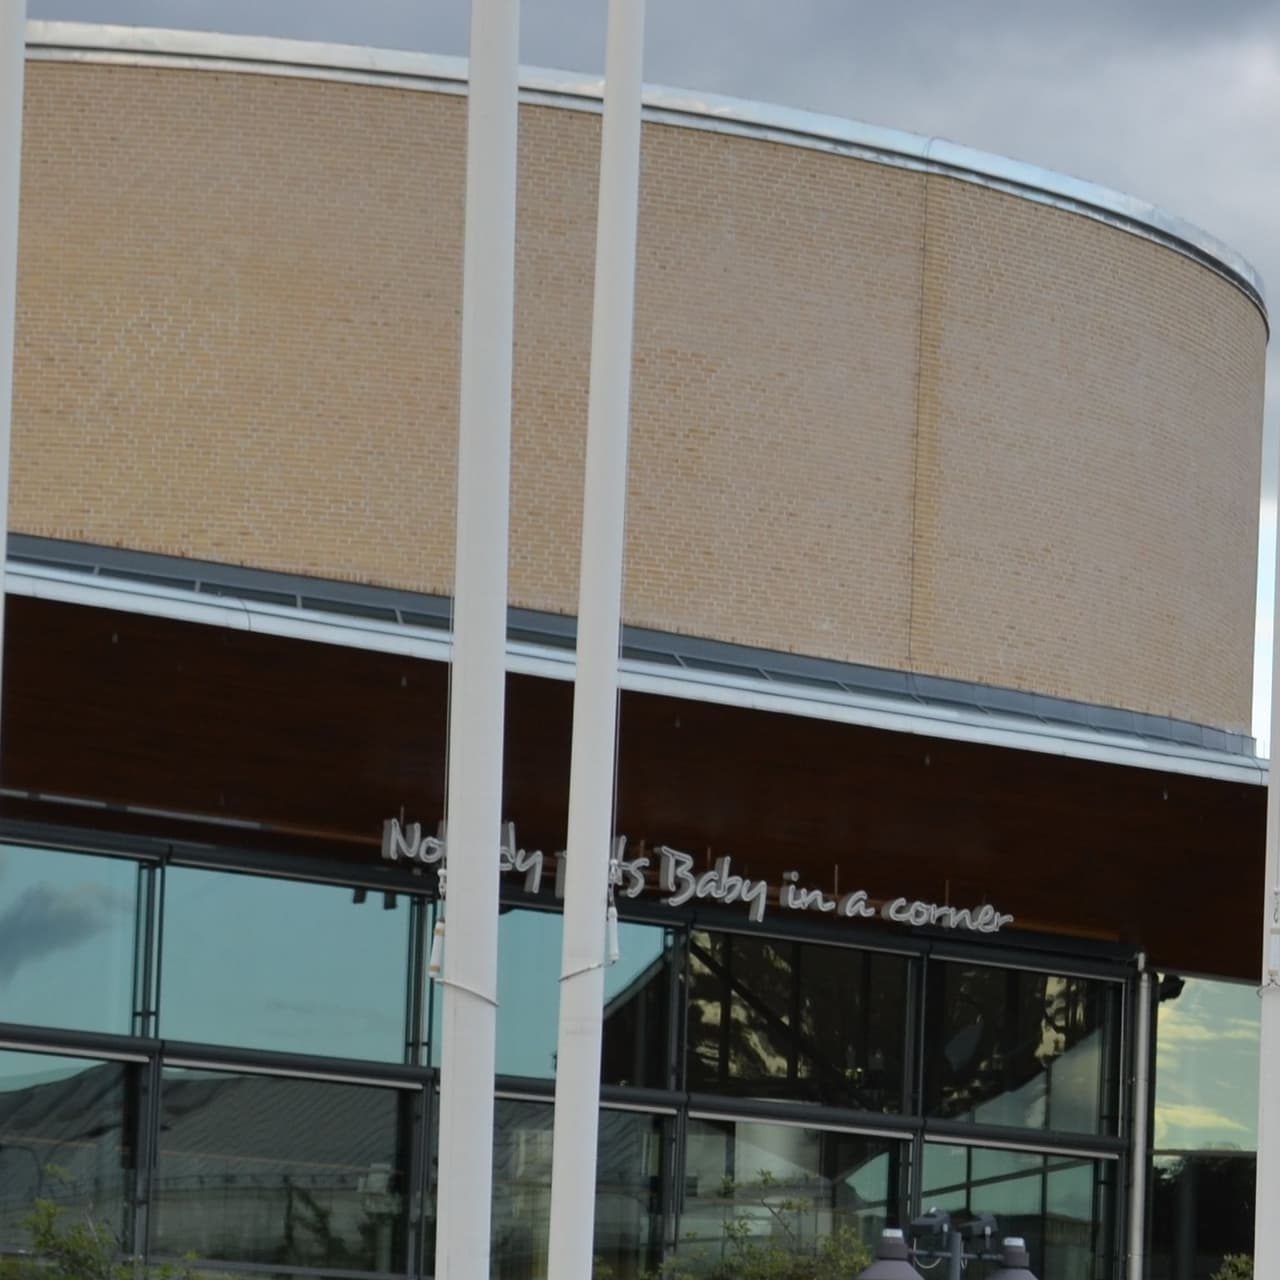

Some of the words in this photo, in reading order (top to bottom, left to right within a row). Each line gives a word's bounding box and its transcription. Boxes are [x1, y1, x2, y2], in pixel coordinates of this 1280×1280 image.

[382, 818, 544, 894] Nody
[654, 845, 767, 923] Baby
[781, 870, 836, 911] in
[838, 890, 876, 918] a
[882, 897, 1015, 933] corner
